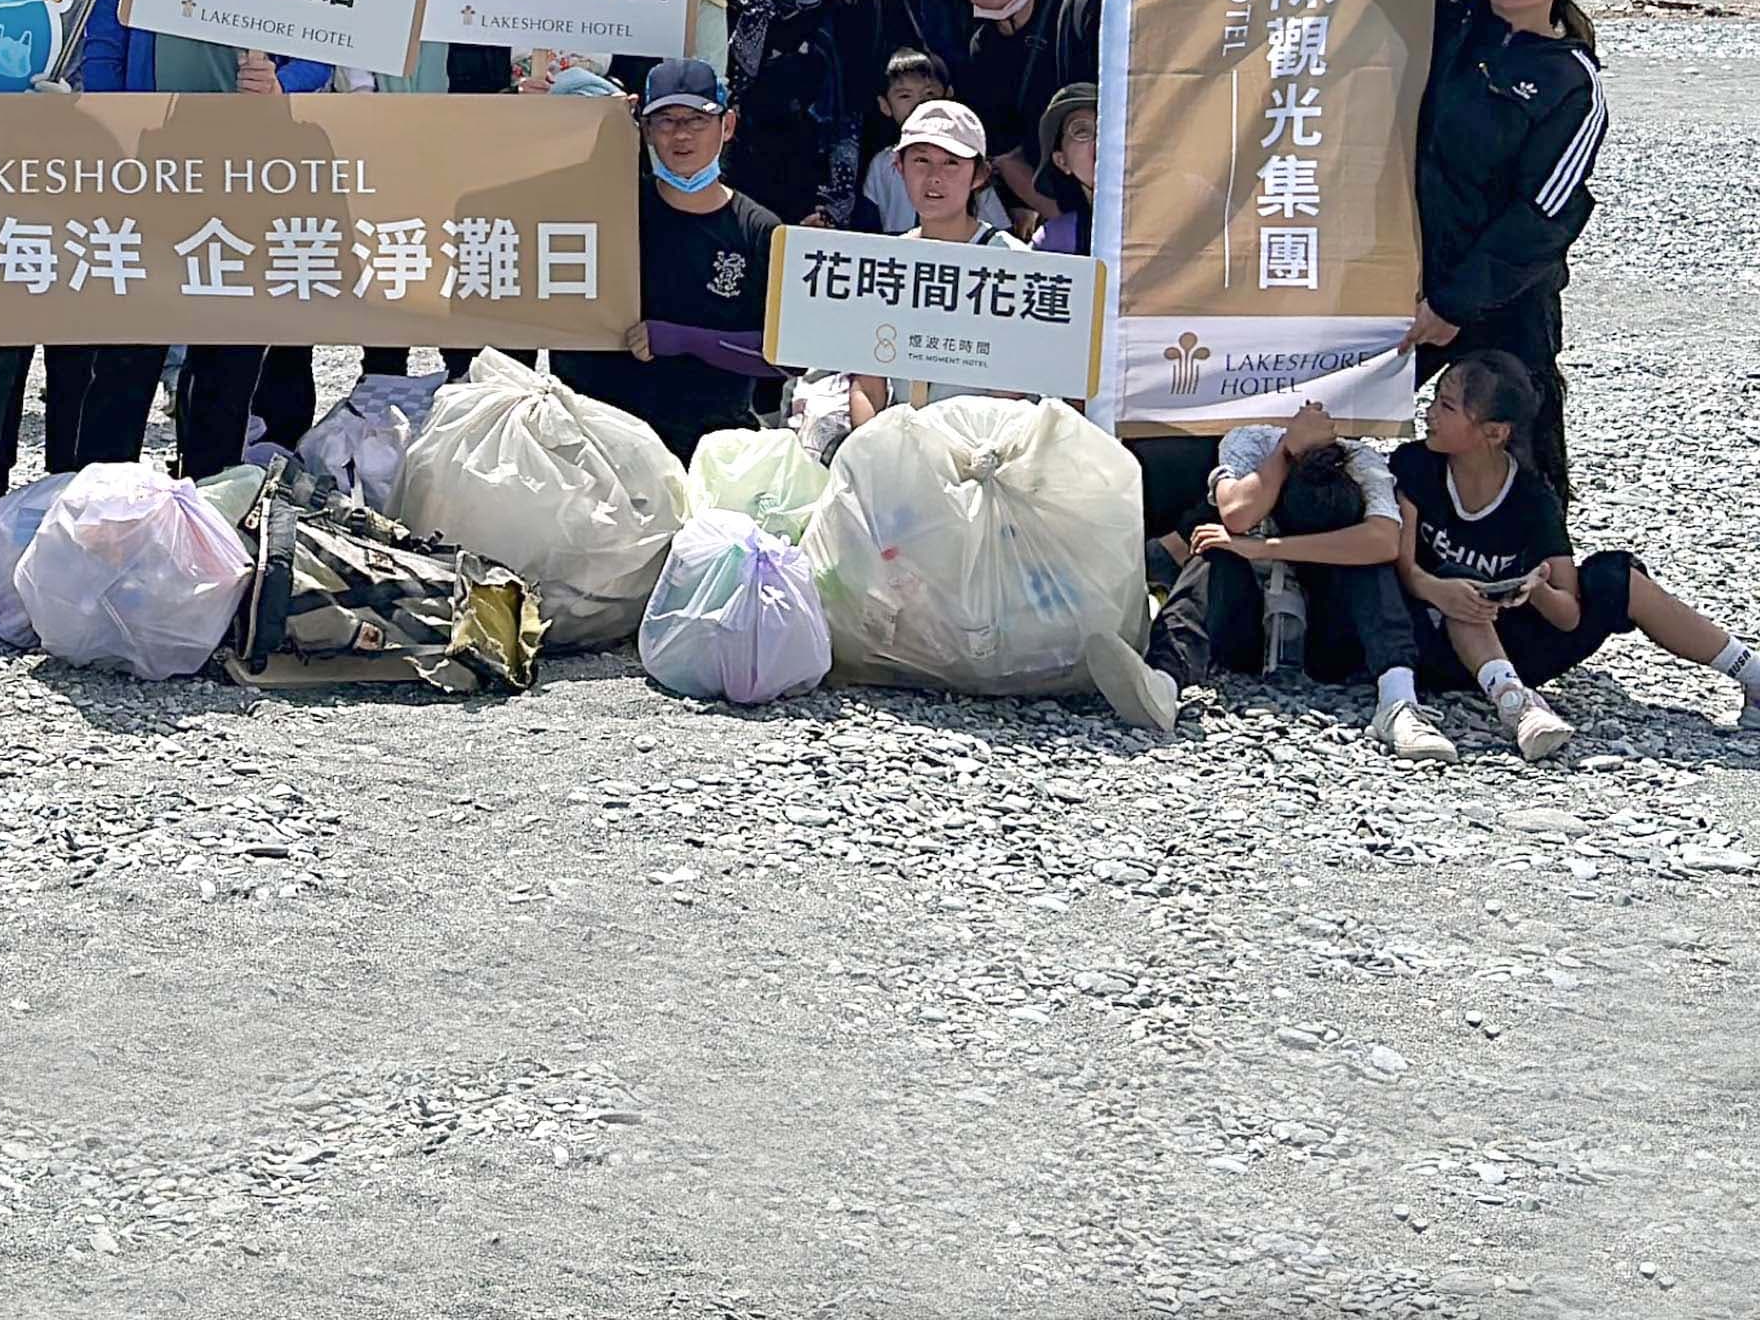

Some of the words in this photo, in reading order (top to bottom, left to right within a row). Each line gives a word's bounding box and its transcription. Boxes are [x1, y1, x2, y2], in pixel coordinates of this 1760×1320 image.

[200, 8, 295, 37] LAKESHORE
[302, 28, 354, 48] HOTEL
[481, 15, 573, 33] LAKESHORE
[581, 22, 633, 37] HOTEL
[224, 160, 376, 193] HOTEL
[174, 216, 598, 300] 企業淨灘日
[802, 250, 1073, 324] 花時間花蓮
[908, 334, 990, 355] 煙波花時間
[1226, 352, 1371, 372] LAKESHORE
[1220, 377, 1302, 395] HOTEL
